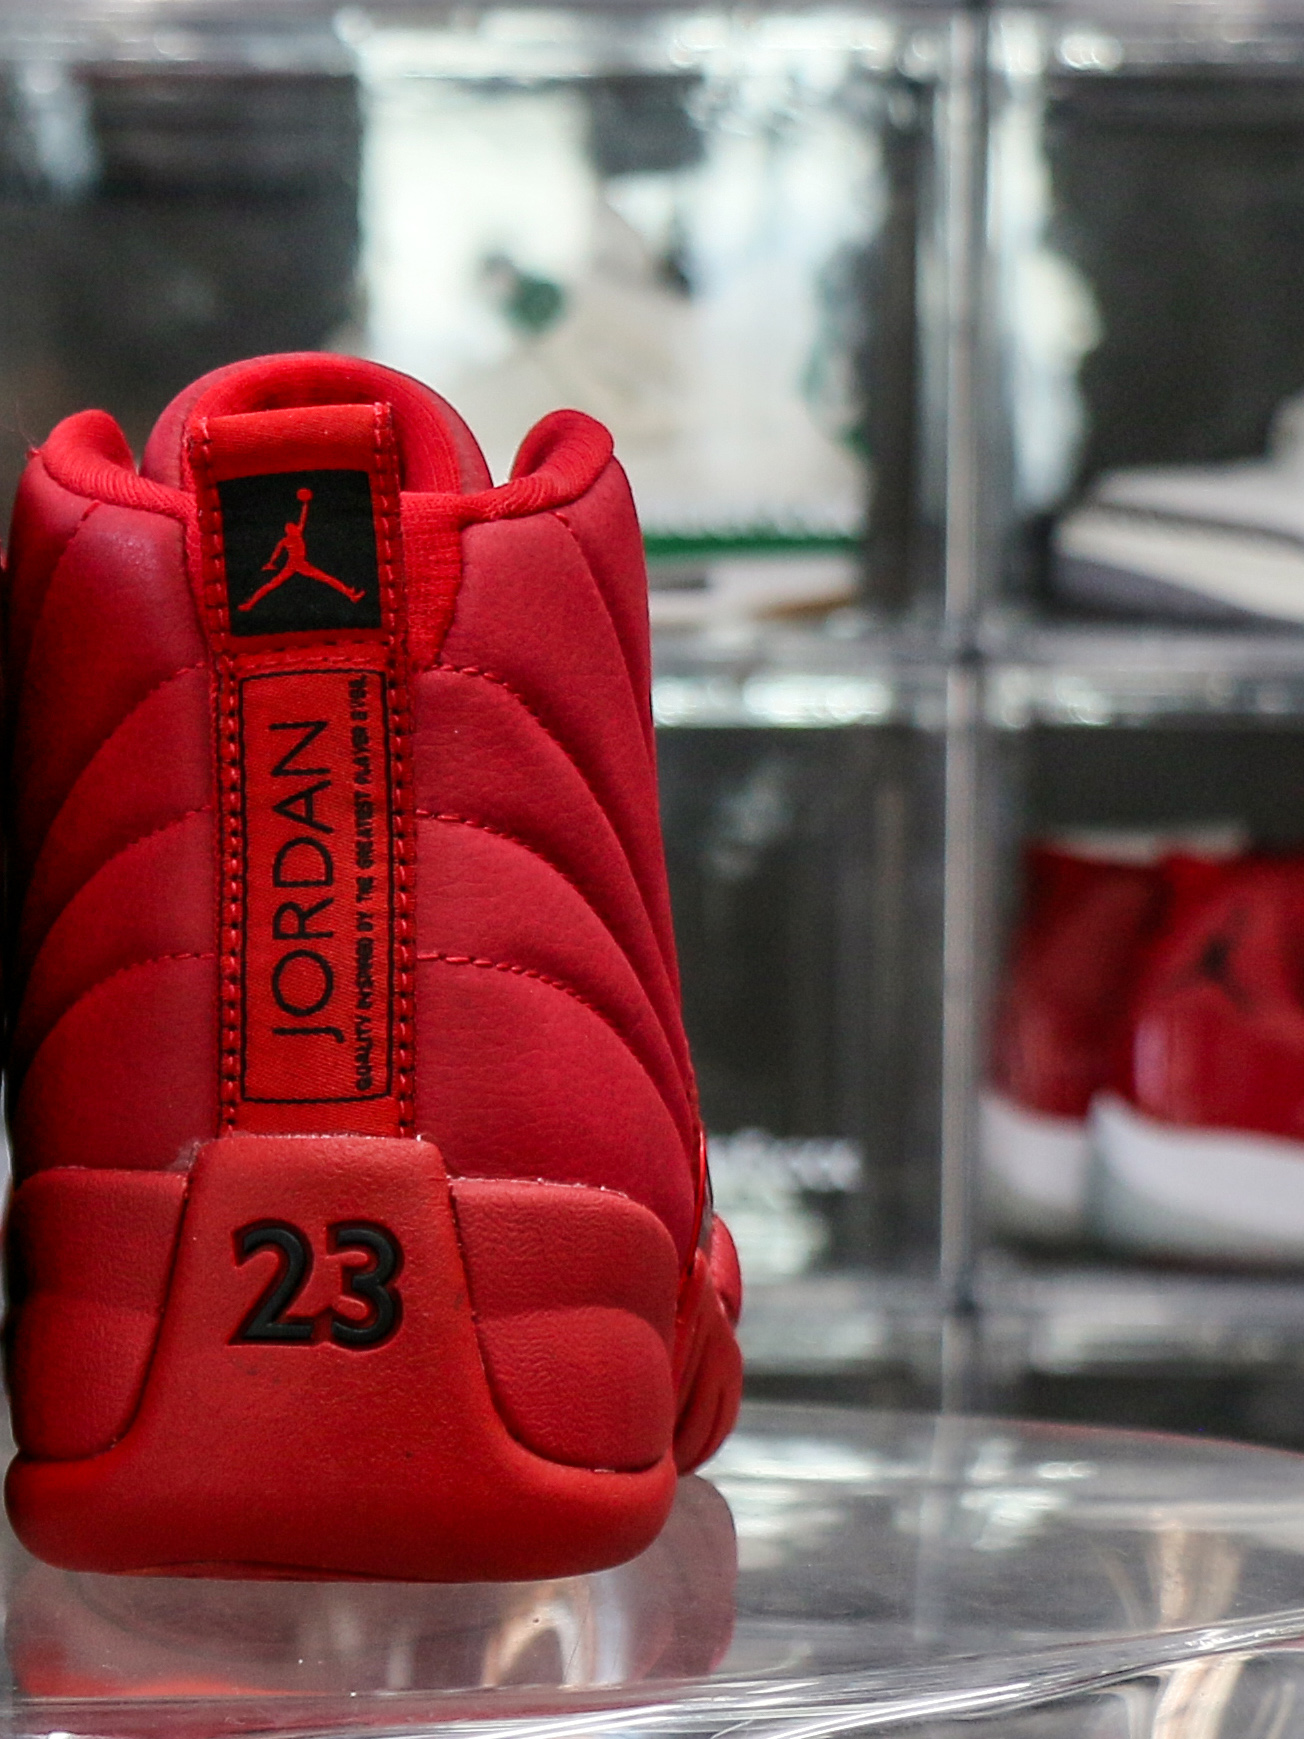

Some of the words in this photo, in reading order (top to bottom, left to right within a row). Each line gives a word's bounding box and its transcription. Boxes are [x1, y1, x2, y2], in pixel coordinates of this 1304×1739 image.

[351, 726, 373, 785] PLAYER
[354, 791, 375, 869] GREATEST
[269, 721, 345, 1044] JORDAN
[356, 876, 375, 903] THE
[356, 911, 375, 932] BY
[355, 937, 375, 1010] INSPIRED
[355, 1015, 374, 1091] QUALITY
[228, 1217, 405, 1352] 23
